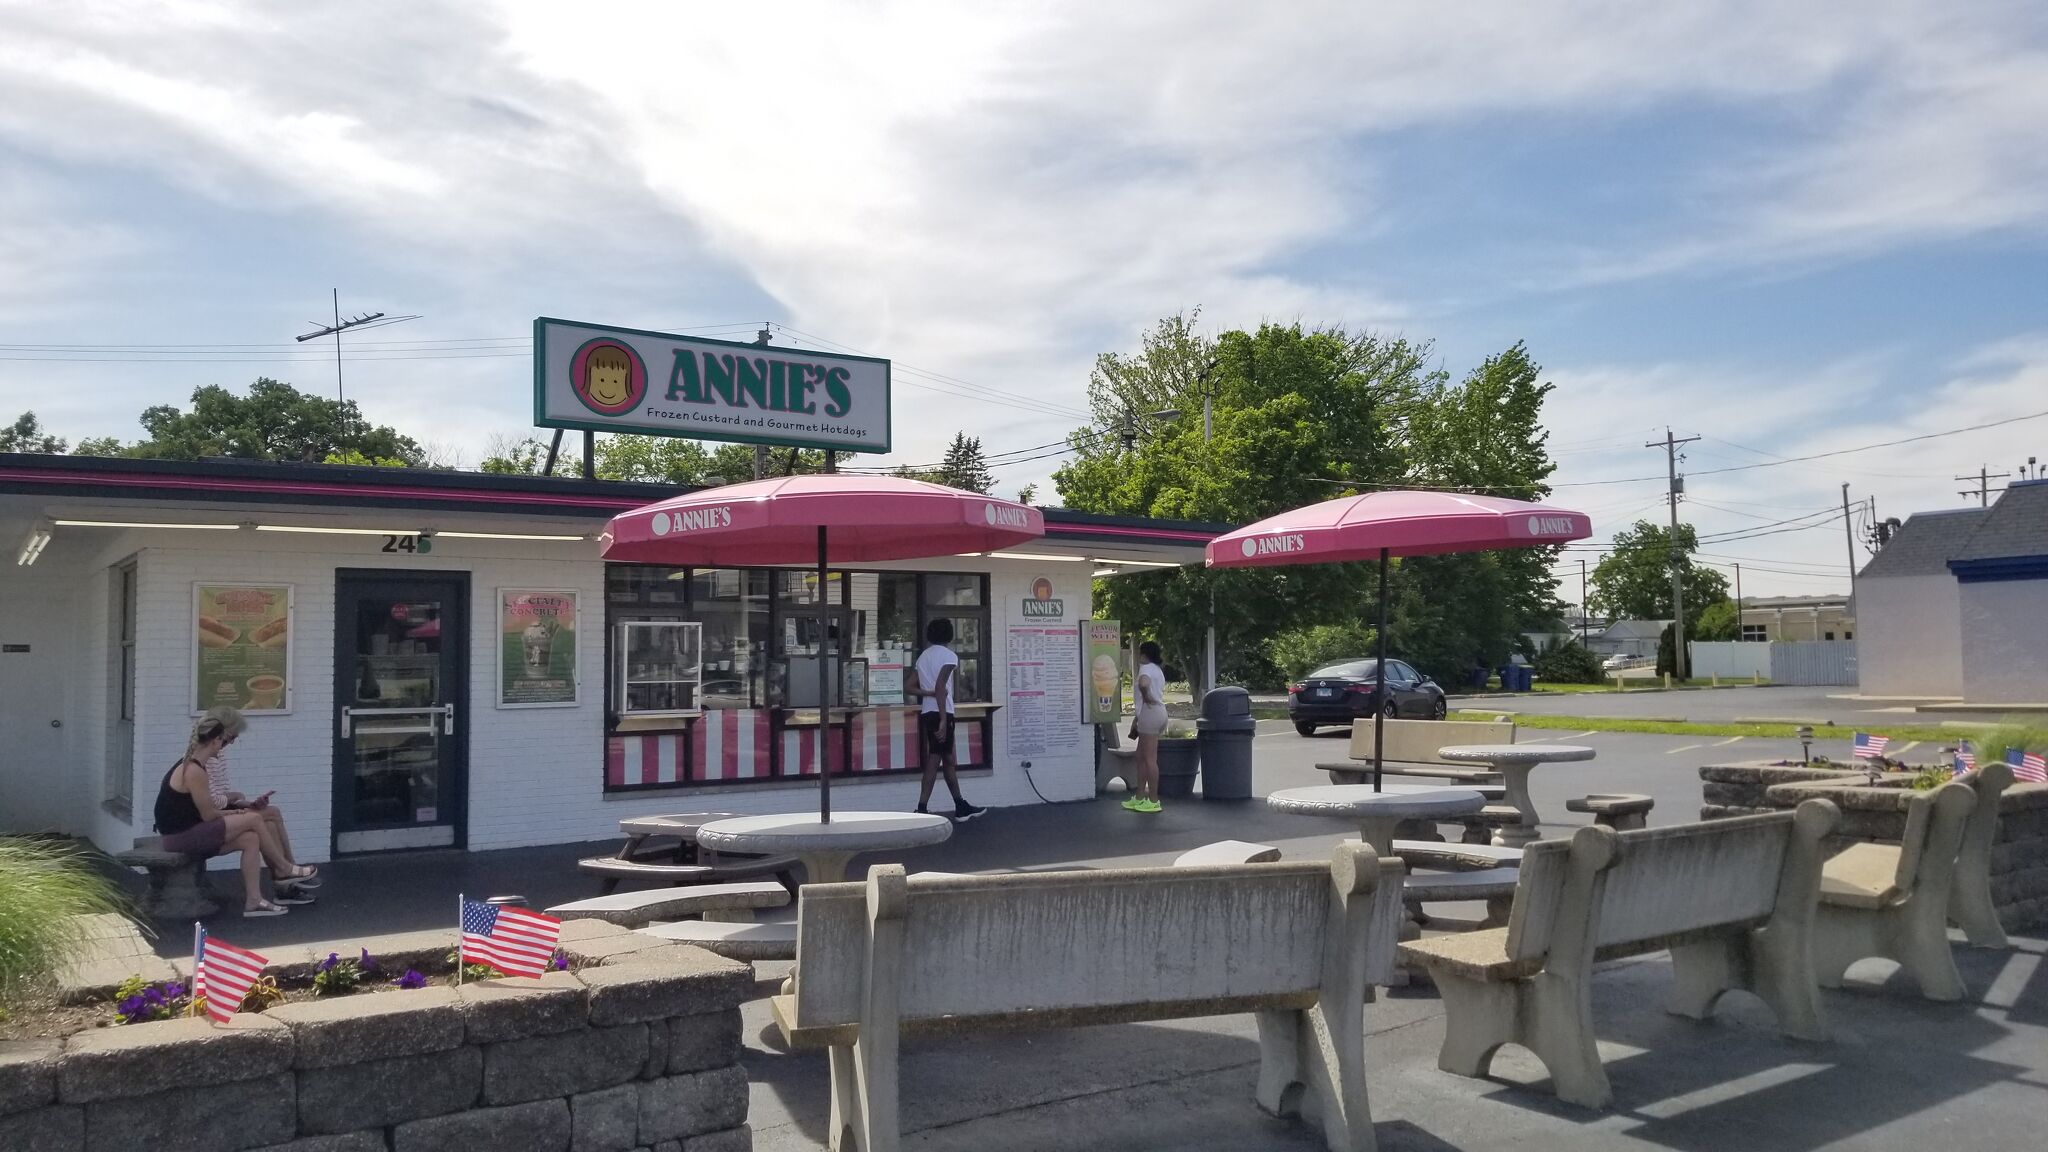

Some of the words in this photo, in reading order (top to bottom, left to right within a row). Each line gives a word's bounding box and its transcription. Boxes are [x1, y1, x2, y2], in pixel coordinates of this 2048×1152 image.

[664, 348, 851, 418] ANNIE'S
[647, 407, 690, 421] Frozen
[692, 411, 740, 425] Custard
[743, 417, 764, 427] and
[767, 418, 819, 432] Gourmet
[821, 423, 867, 437] Hotdogs
[672, 506, 731, 532] ANNIE'S
[997, 506, 1028, 528] ANNIE'S
[1540, 517, 1573, 534] ANNIE'S
[1258, 533, 1304, 555] ANNIE'S
[1024, 601, 1062, 615] ANNIE'S
